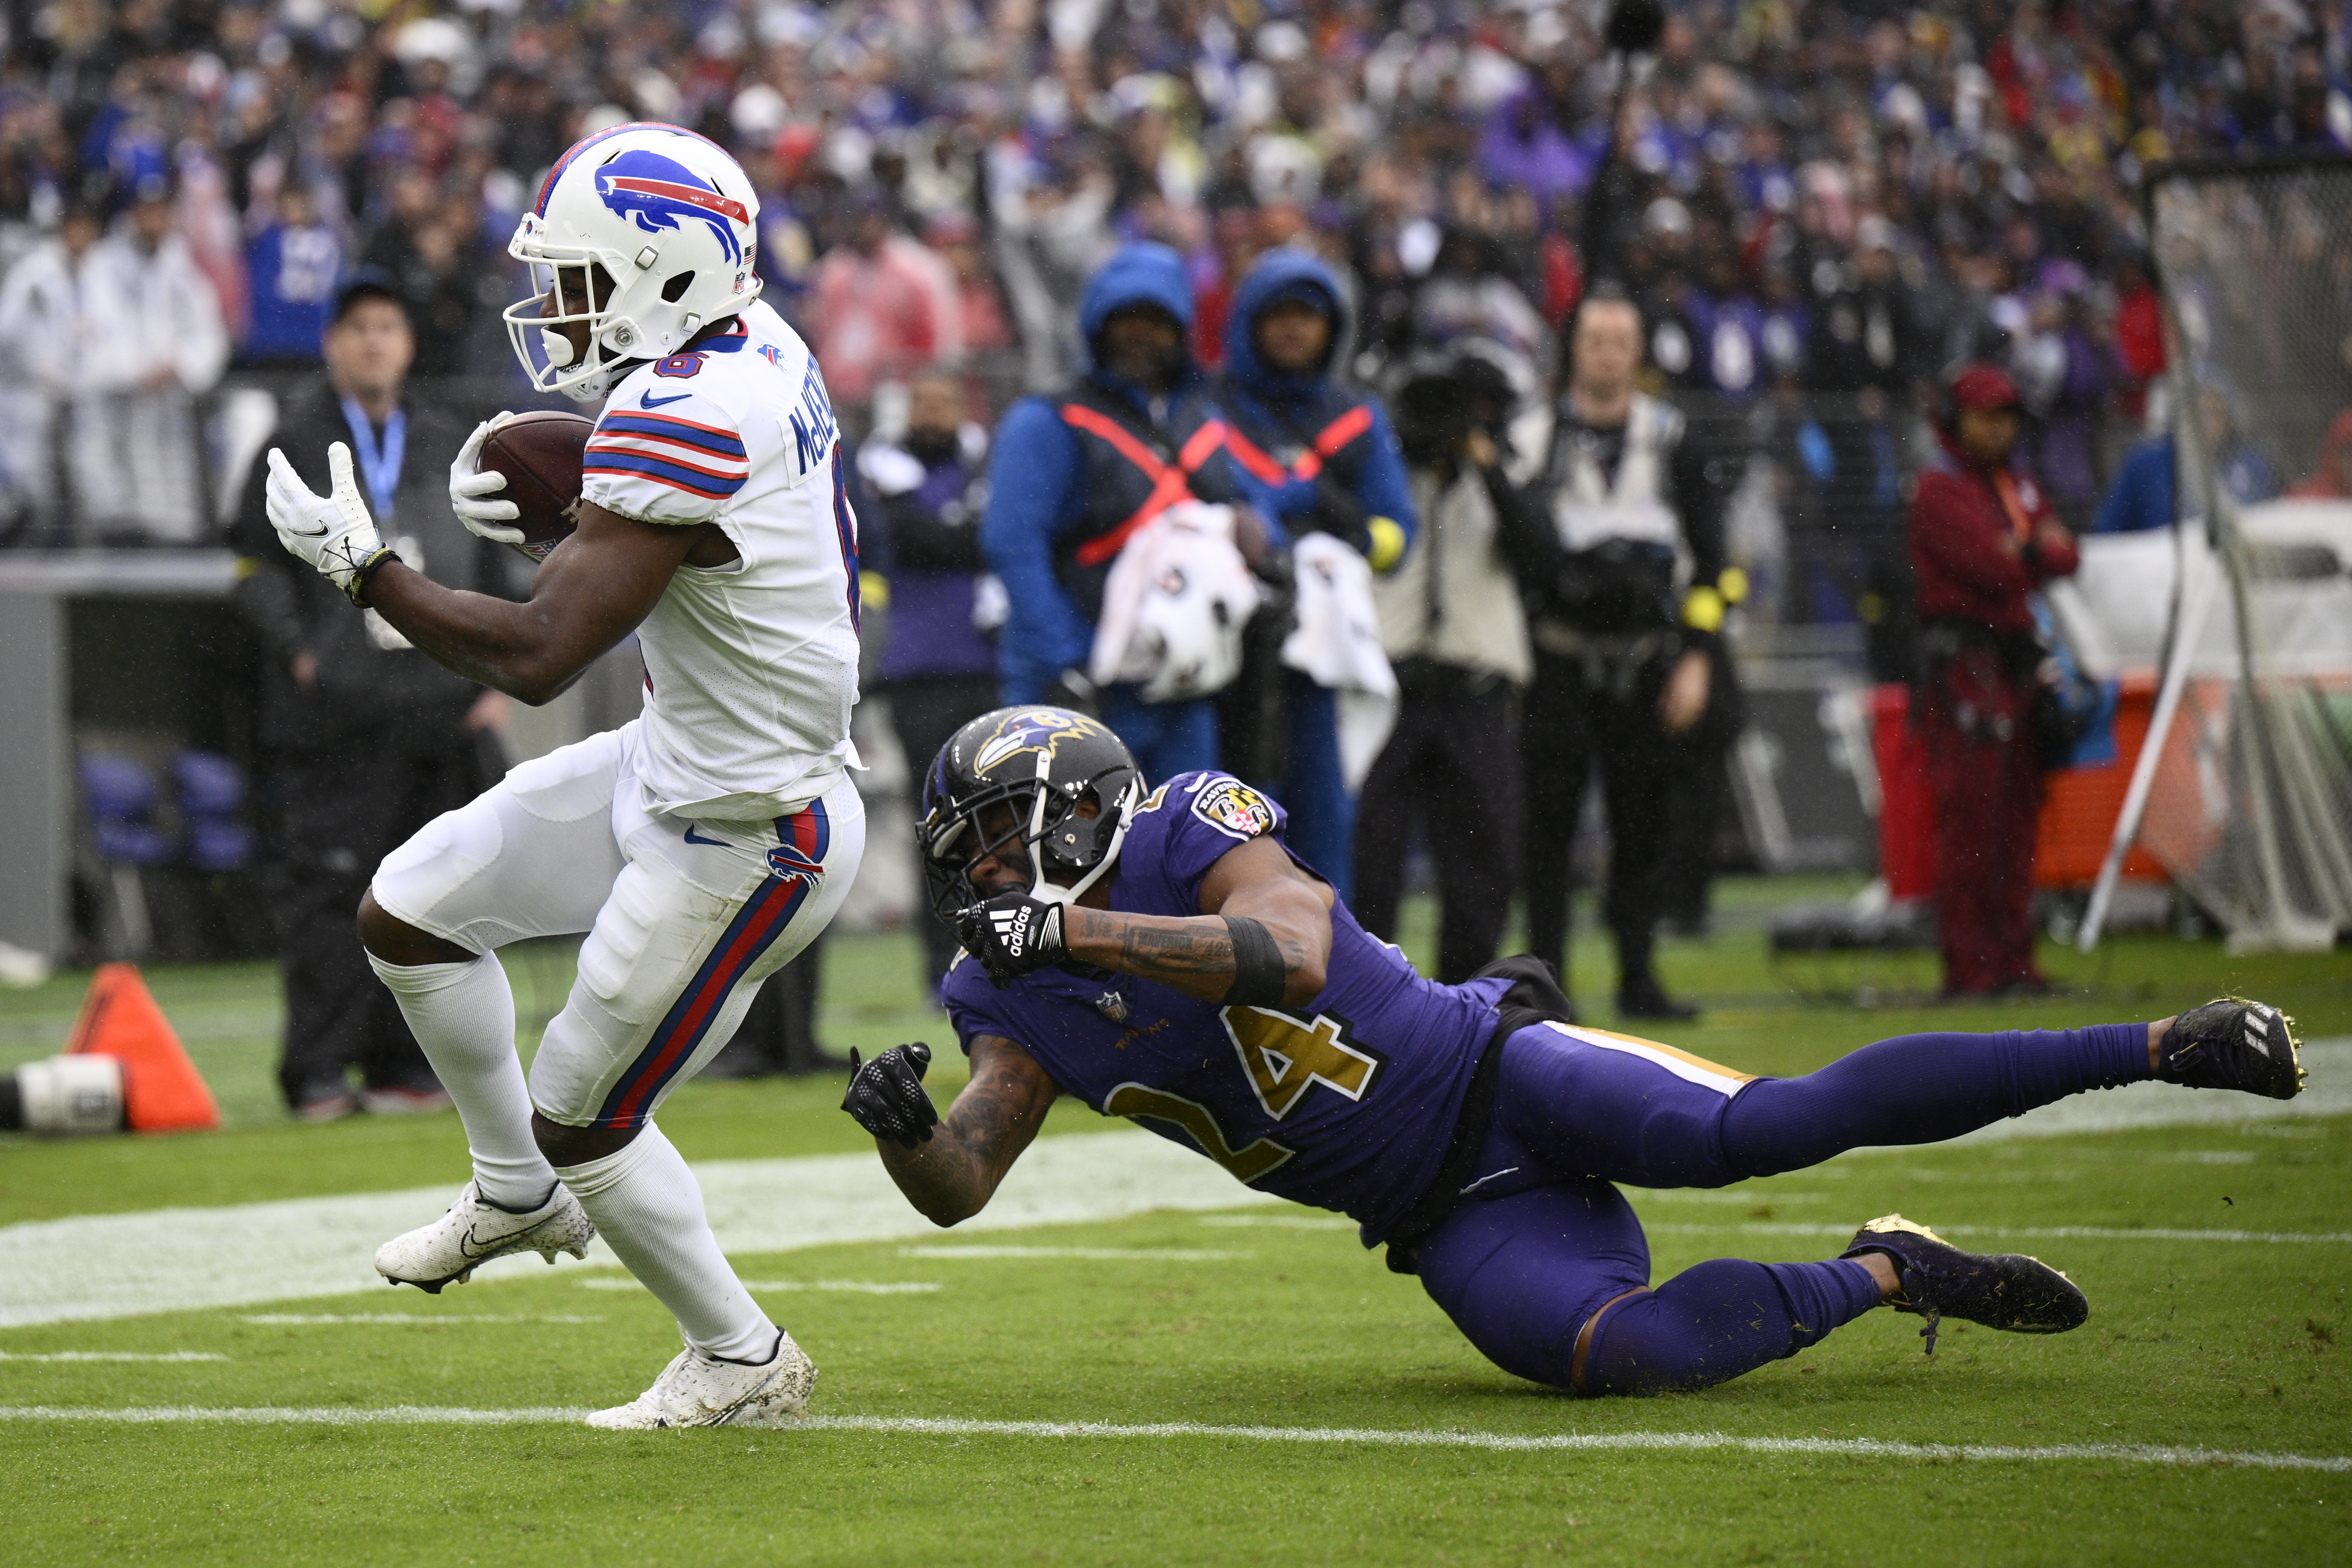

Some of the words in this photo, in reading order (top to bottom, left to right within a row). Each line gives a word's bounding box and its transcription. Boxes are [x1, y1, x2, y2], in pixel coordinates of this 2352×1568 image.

[734, 280, 743, 292] NFL
[652, 352, 710, 379] 6
[788, 349, 834, 476] McKENZ
[1031, 710, 1072, 728] B
[1199, 782, 1240, 810] RAVENS
[1208, 794, 1237, 820] B
[1244, 803, 1270, 825] R
[1010, 905, 1032, 957] adidas
[1103, 1005, 1385, 1184] 24
